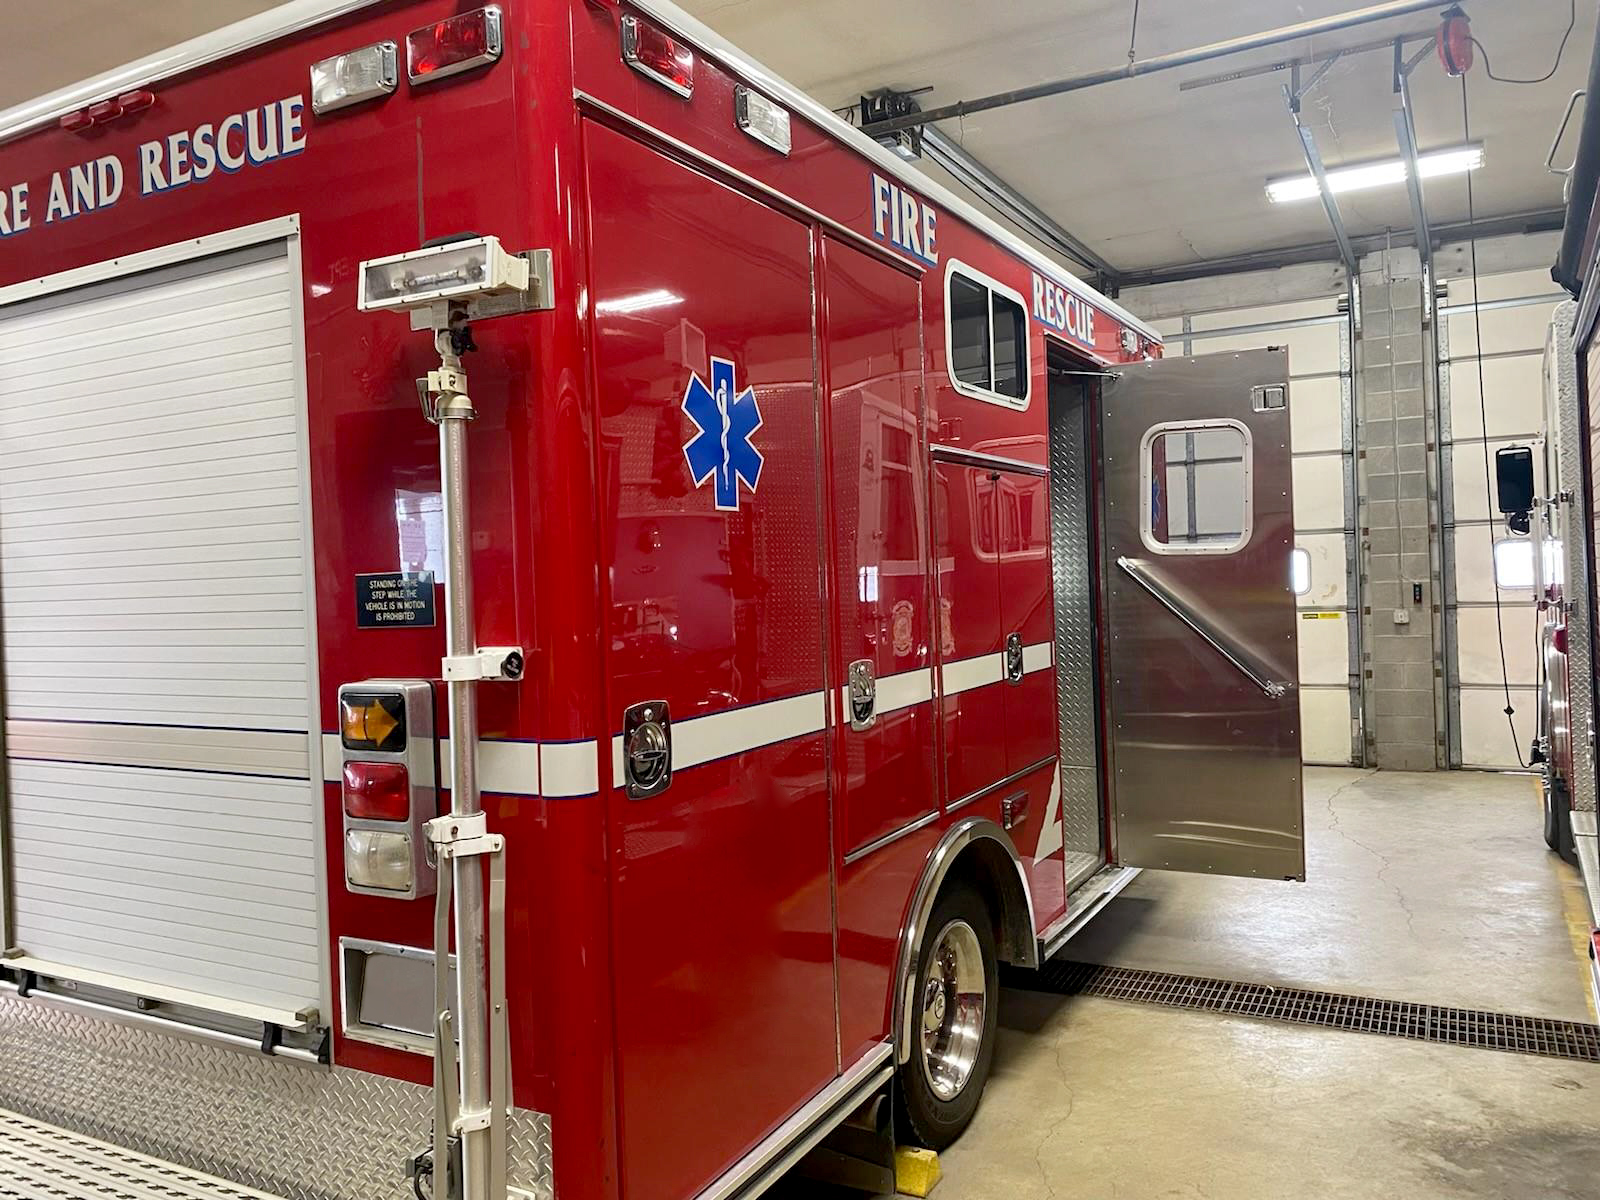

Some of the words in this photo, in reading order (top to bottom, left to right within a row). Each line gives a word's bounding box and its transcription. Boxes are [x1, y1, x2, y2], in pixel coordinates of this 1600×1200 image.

[45, 155, 124, 223] AND
[139, 94, 307, 196] RESCUE
[872, 172, 939, 267] FIRE
[1031, 271, 1097, 349] RESCUE
[369, 580, 396, 589] STANDING
[371, 590, 386, 600] STEP
[387, 590, 404, 598] WHILE
[406, 589, 417, 598] THE
[365, 601, 388, 611] VEHICLE
[389, 601, 396, 610] IS
[397, 601, 403, 609] IN
[404, 600, 425, 609] MOTION
[376, 612, 382, 621] IS
[383, 612, 415, 620] PROHIBITED
